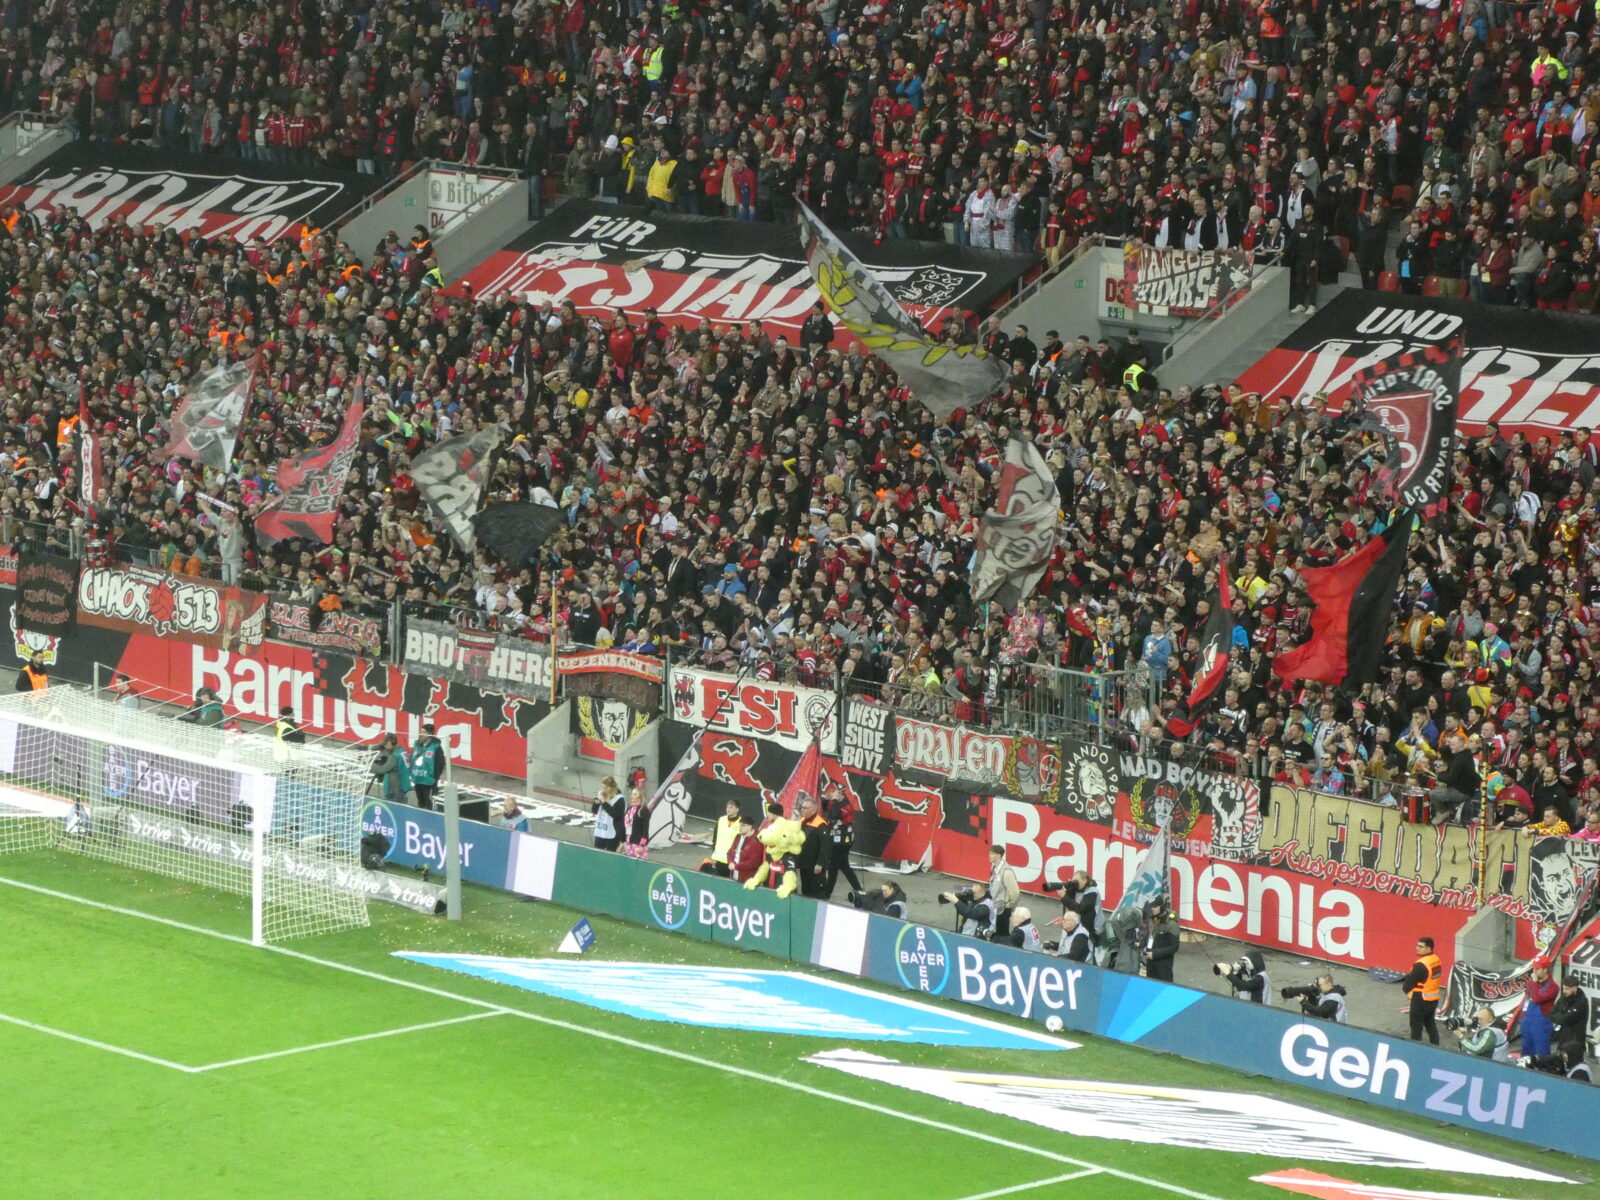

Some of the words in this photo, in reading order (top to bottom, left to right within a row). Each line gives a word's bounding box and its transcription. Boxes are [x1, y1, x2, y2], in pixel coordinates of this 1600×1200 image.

[569, 215, 657, 246] FÜR
[1356, 307, 1463, 340] UND
[176, 585, 219, 632] 513
[701, 679, 798, 733] FSI
[849, 702, 889, 731] WEST
[842, 746, 883, 775] BOYZ
[845, 724, 885, 754] SIDE
[137, 759, 199, 805] Bayer
[1065, 745, 1109, 814] COMMANDO
[1107, 766, 1119, 805] 1989
[1119, 755, 1162, 780] MAD
[1259, 784, 1531, 908] DIFFIDATI
[401, 887, 436, 908] trive
[651, 889, 688, 908] BAYER
[991, 796, 1366, 961] Barmenia
[1270, 841, 1435, 903] Ausgesperrte
[1440, 886, 1478, 911] mit
[699, 888, 775, 942] Bayer
[900, 950, 945, 967] BAYER
[956, 946, 1083, 1018] Bayer
[1280, 1023, 1410, 1101] Geh
[1425, 1067, 1547, 1129] zur
